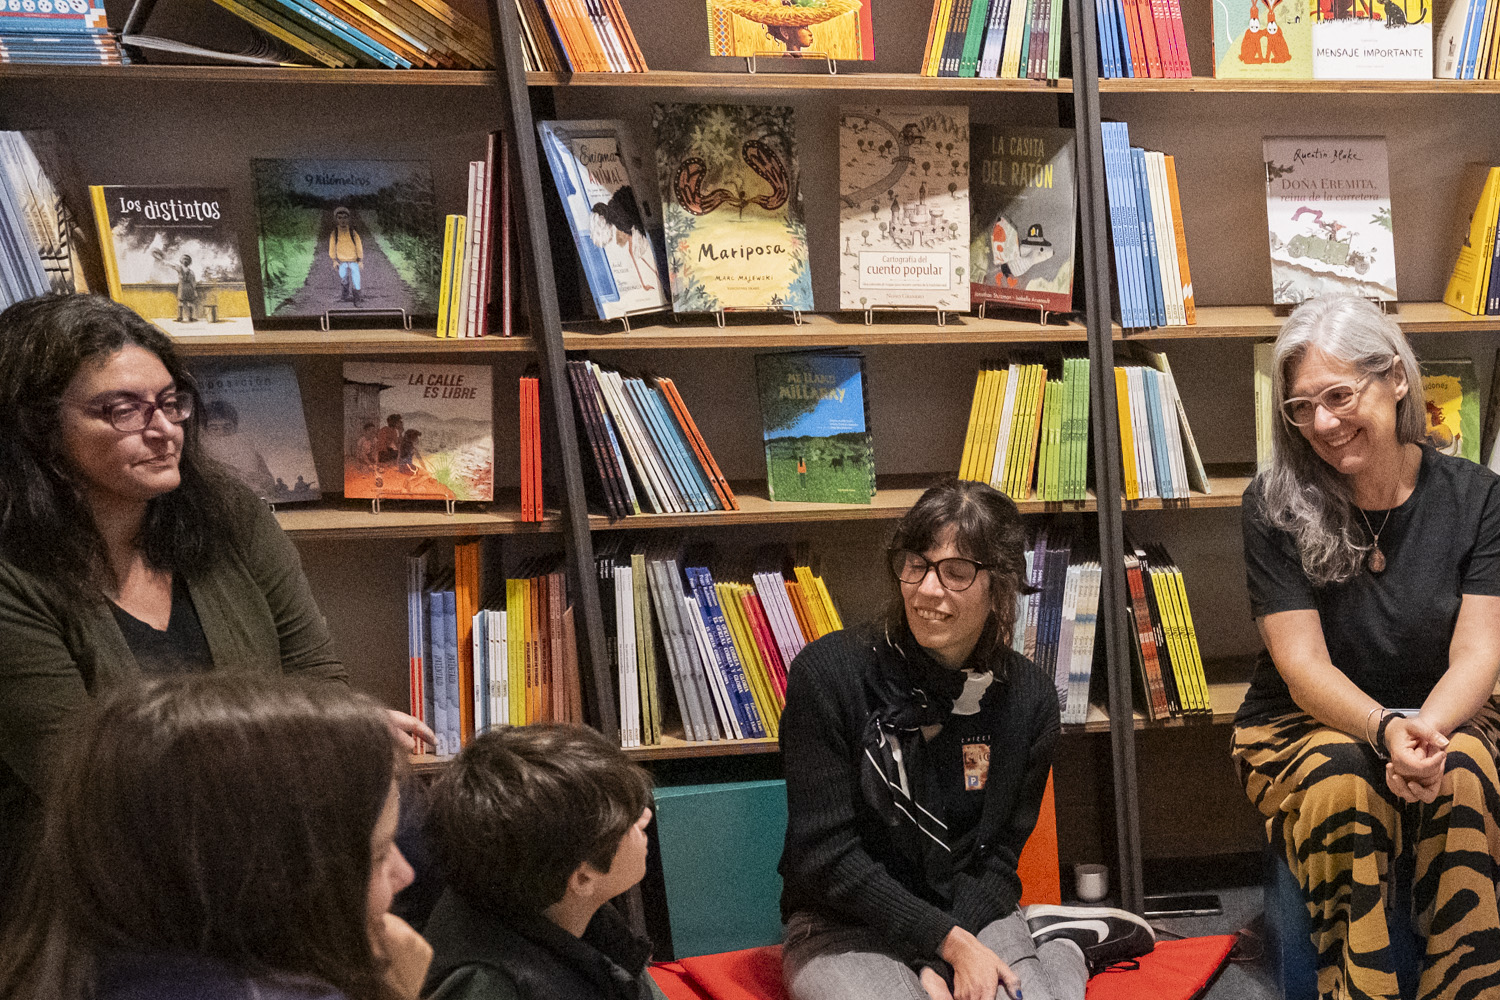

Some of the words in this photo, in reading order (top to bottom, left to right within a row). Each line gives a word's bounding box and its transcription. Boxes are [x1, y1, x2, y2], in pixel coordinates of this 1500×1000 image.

[1316, 48, 1360, 58] MENSAJE
[1363, 48, 1424, 58] IMPORTANTE
[992, 137, 1004, 154] LA
[1011, 138, 1045, 157] CASITA
[1294, 149, 1328, 165] Quentin
[1331, 149, 1363, 162] Blake
[306, 175, 314, 186] 9
[589, 168, 623, 184] ANIMAL
[982, 161, 1005, 185] DEL
[1011, 159, 1054, 188] RATÓN
[1281, 177, 1318, 190] DOÑA
[1320, 178, 1377, 191] EREMITA,
[1280, 191, 1306, 202] reina
[1308, 191, 1321, 202] de
[1324, 191, 1332, 202] la
[1335, 192, 1380, 202] carretera
[119, 197, 142, 214] Los
[144, 200, 220, 222] distintos
[698, 242, 786, 262] Mariposa
[882, 255, 920, 265] Cartografía
[867, 264, 900, 276] cuento
[903, 264, 944, 278] popular
[408, 373, 424, 386] LA
[427, 374, 464, 387] CALLE
[423, 386, 439, 398] ES
[442, 386, 478, 400] LIBRE
